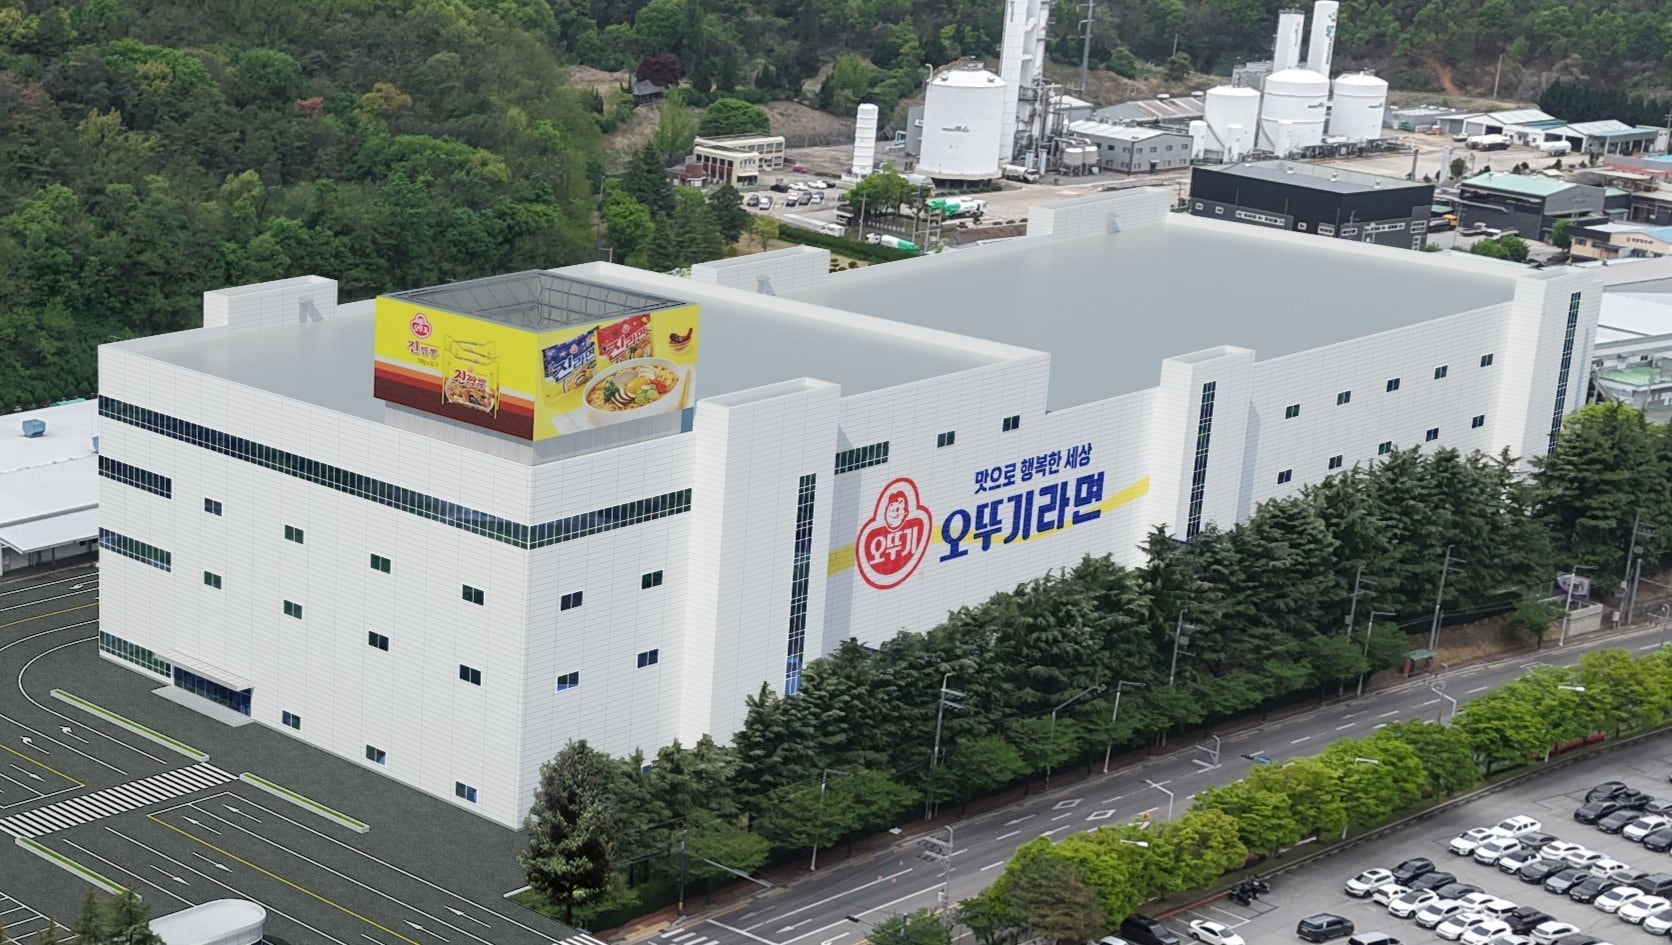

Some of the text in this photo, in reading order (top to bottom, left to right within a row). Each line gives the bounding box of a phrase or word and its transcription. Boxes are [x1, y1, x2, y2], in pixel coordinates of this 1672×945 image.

[974, 442, 1093, 494] 맛으로 행복한 세상
[939, 470, 1105, 563] 오뚜기라면
[870, 526, 919, 565] 오뚜기
